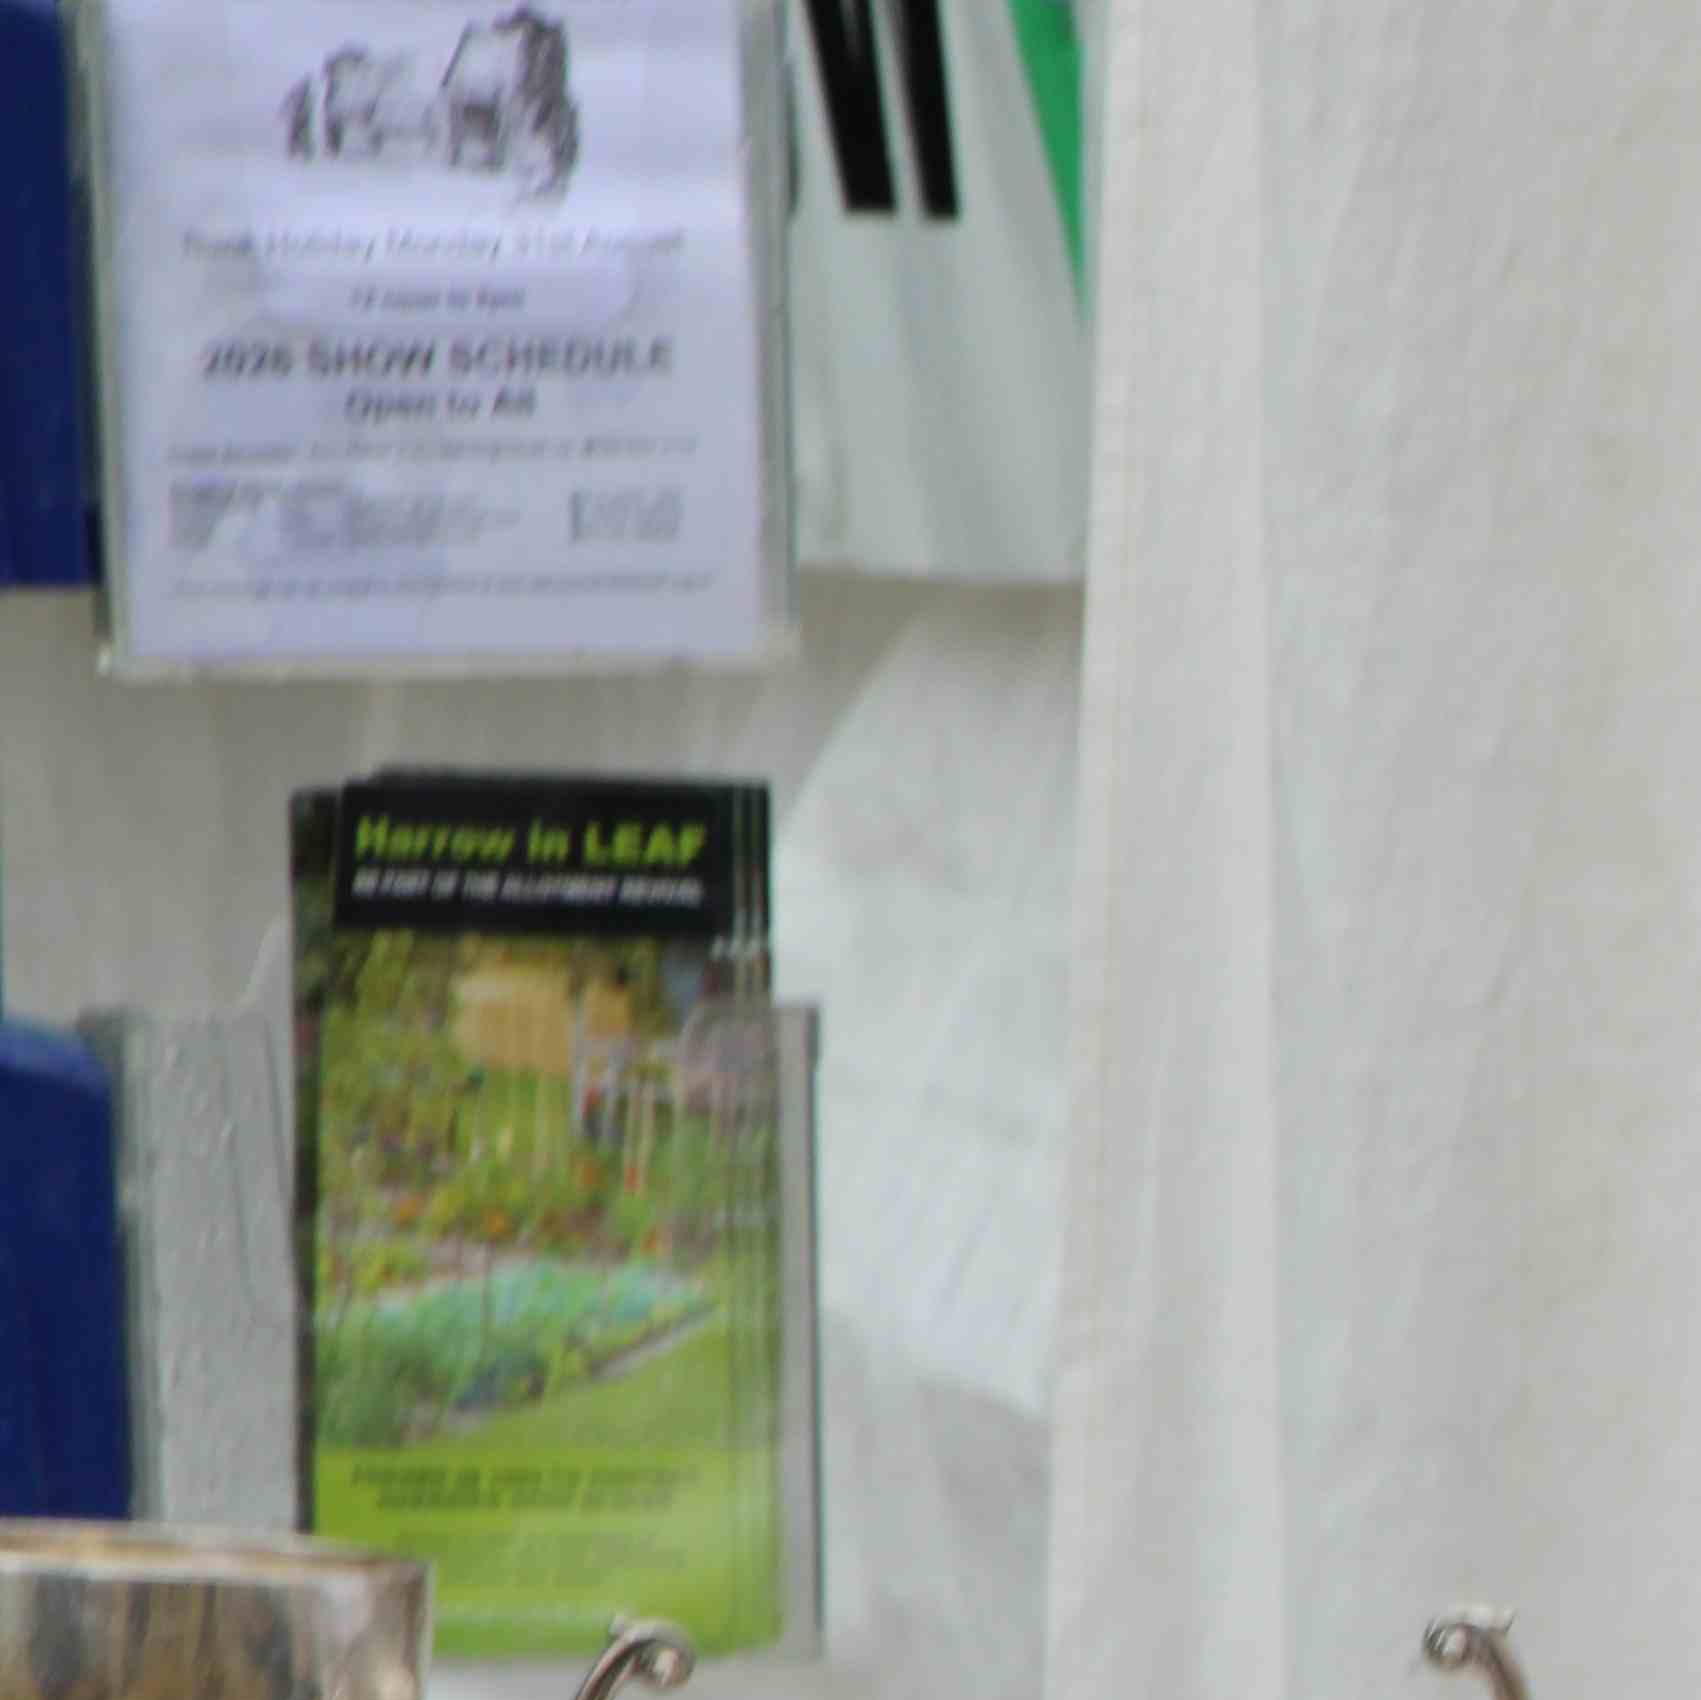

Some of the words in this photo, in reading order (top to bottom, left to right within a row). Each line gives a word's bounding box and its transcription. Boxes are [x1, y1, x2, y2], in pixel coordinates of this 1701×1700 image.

[306, 334, 437, 380] SHOW
[448, 333, 674, 379] SCHEDULE
[344, 387, 437, 424] Open
[446, 387, 480, 418] to
[355, 814, 516, 864] Harrow
[583, 819, 705, 868] LEAF
